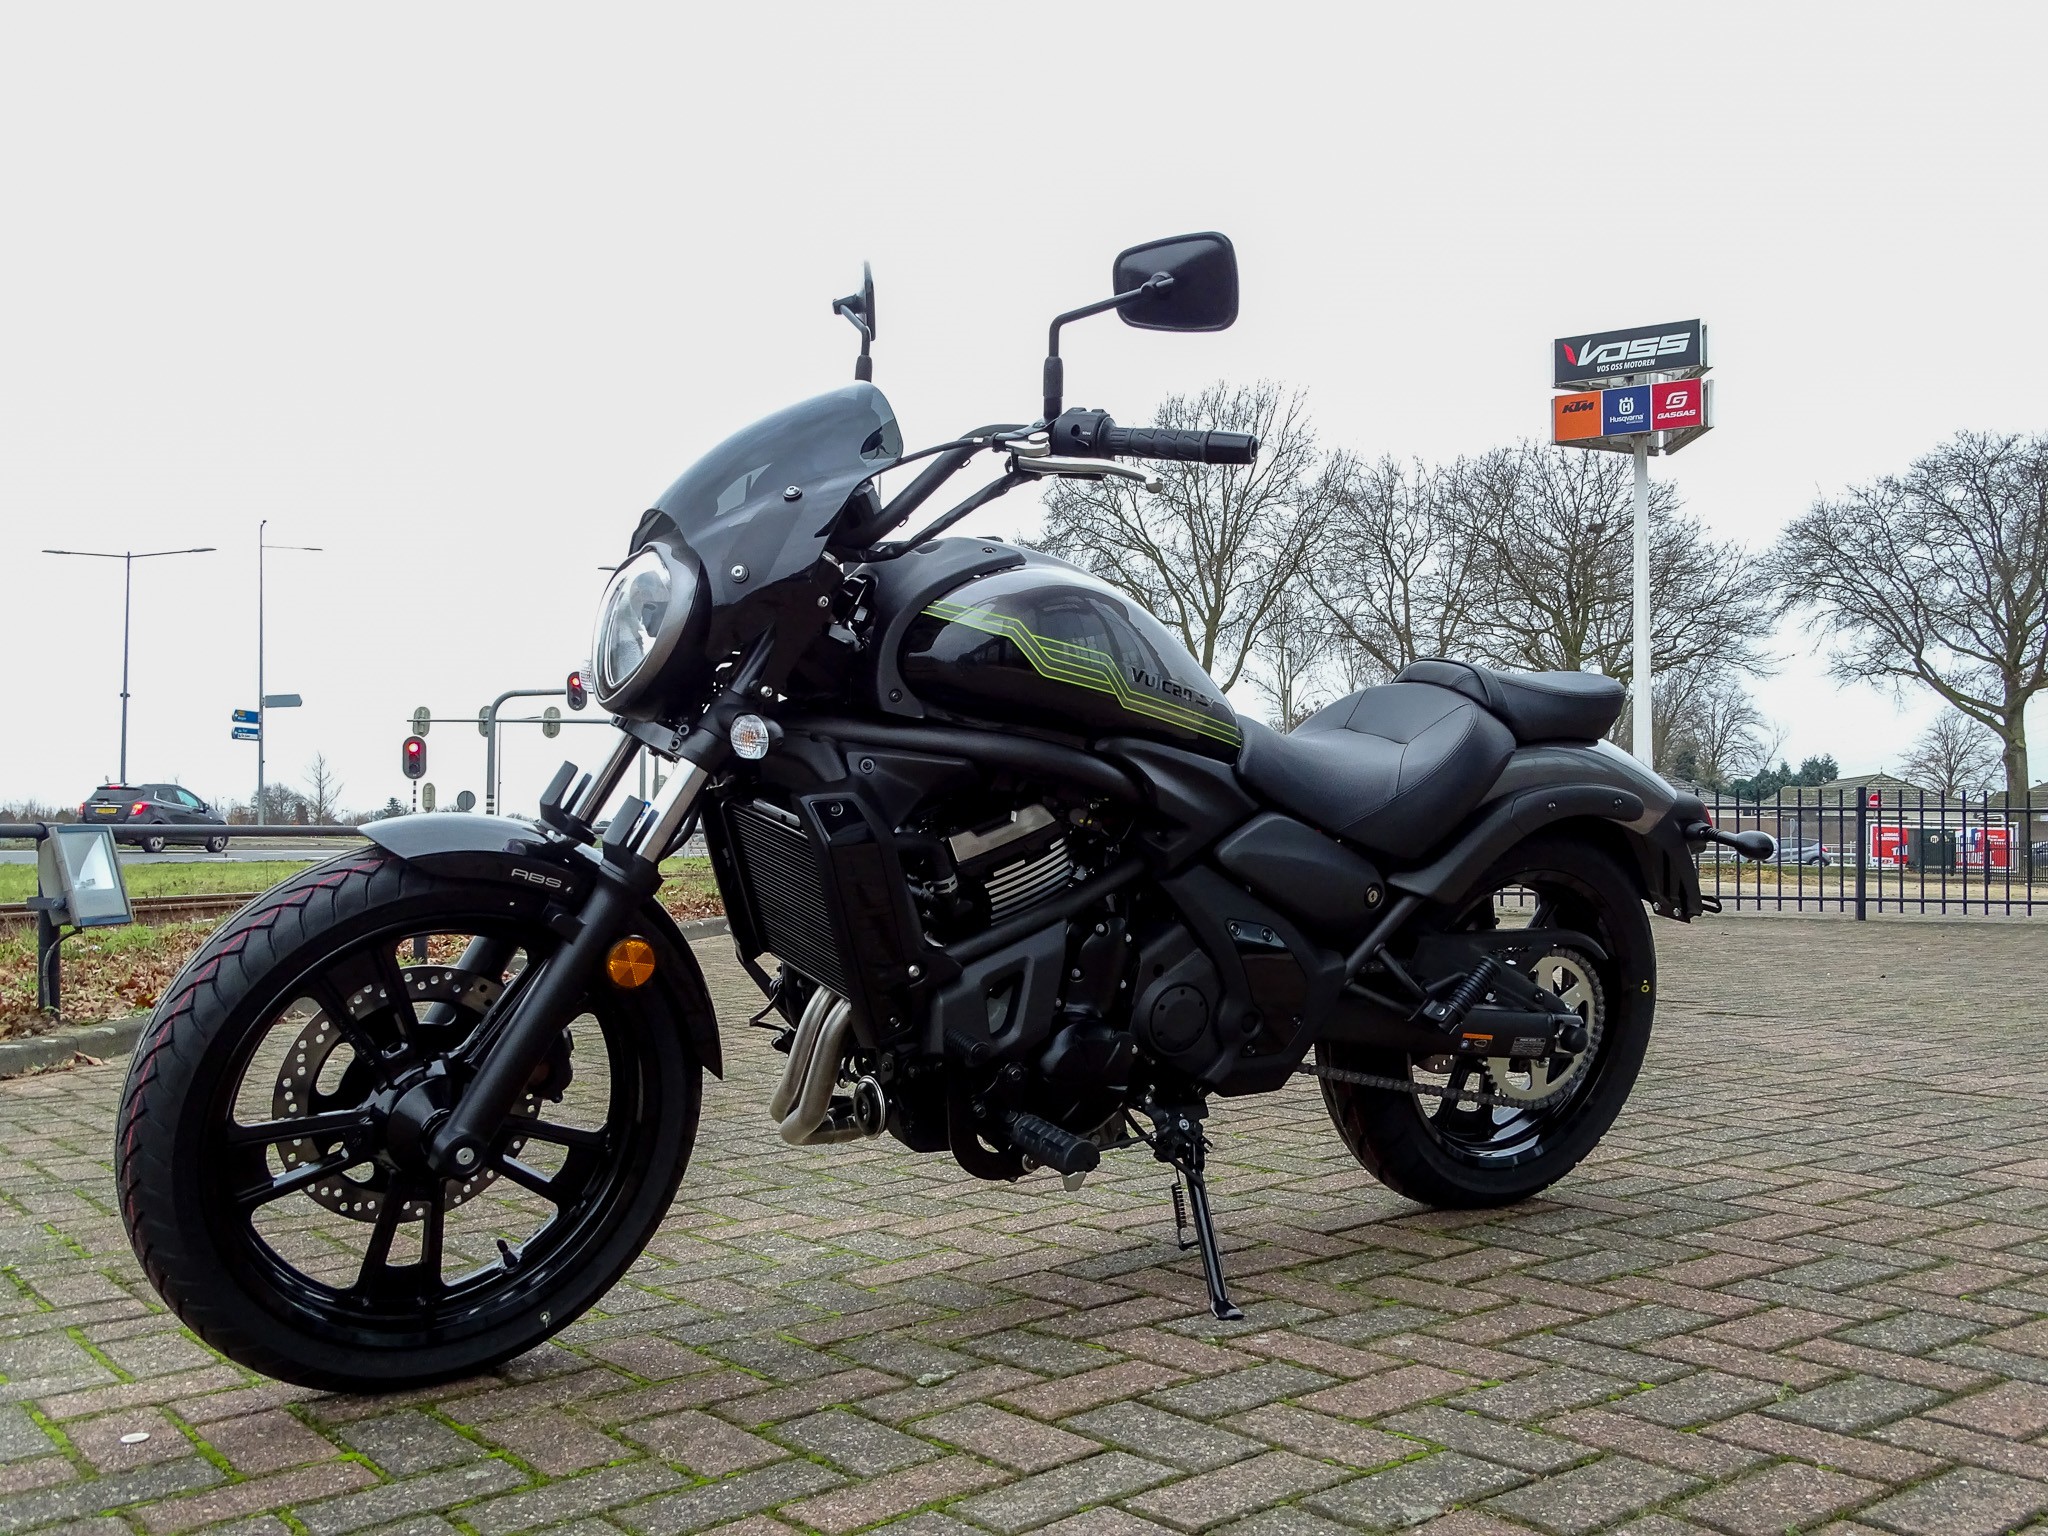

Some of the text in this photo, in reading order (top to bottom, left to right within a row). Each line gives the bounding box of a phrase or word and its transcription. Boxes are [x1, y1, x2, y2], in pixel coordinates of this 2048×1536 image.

[1563, 332, 1691, 366] VOSS
[1596, 358, 1656, 373] VOS OSS MOTOREN
[1562, 400, 1594, 414] KTM
[1657, 409, 1697, 419] GASGAS
[1609, 414, 1644, 424] Husqvarna
[511, 868, 562, 888] ABS
